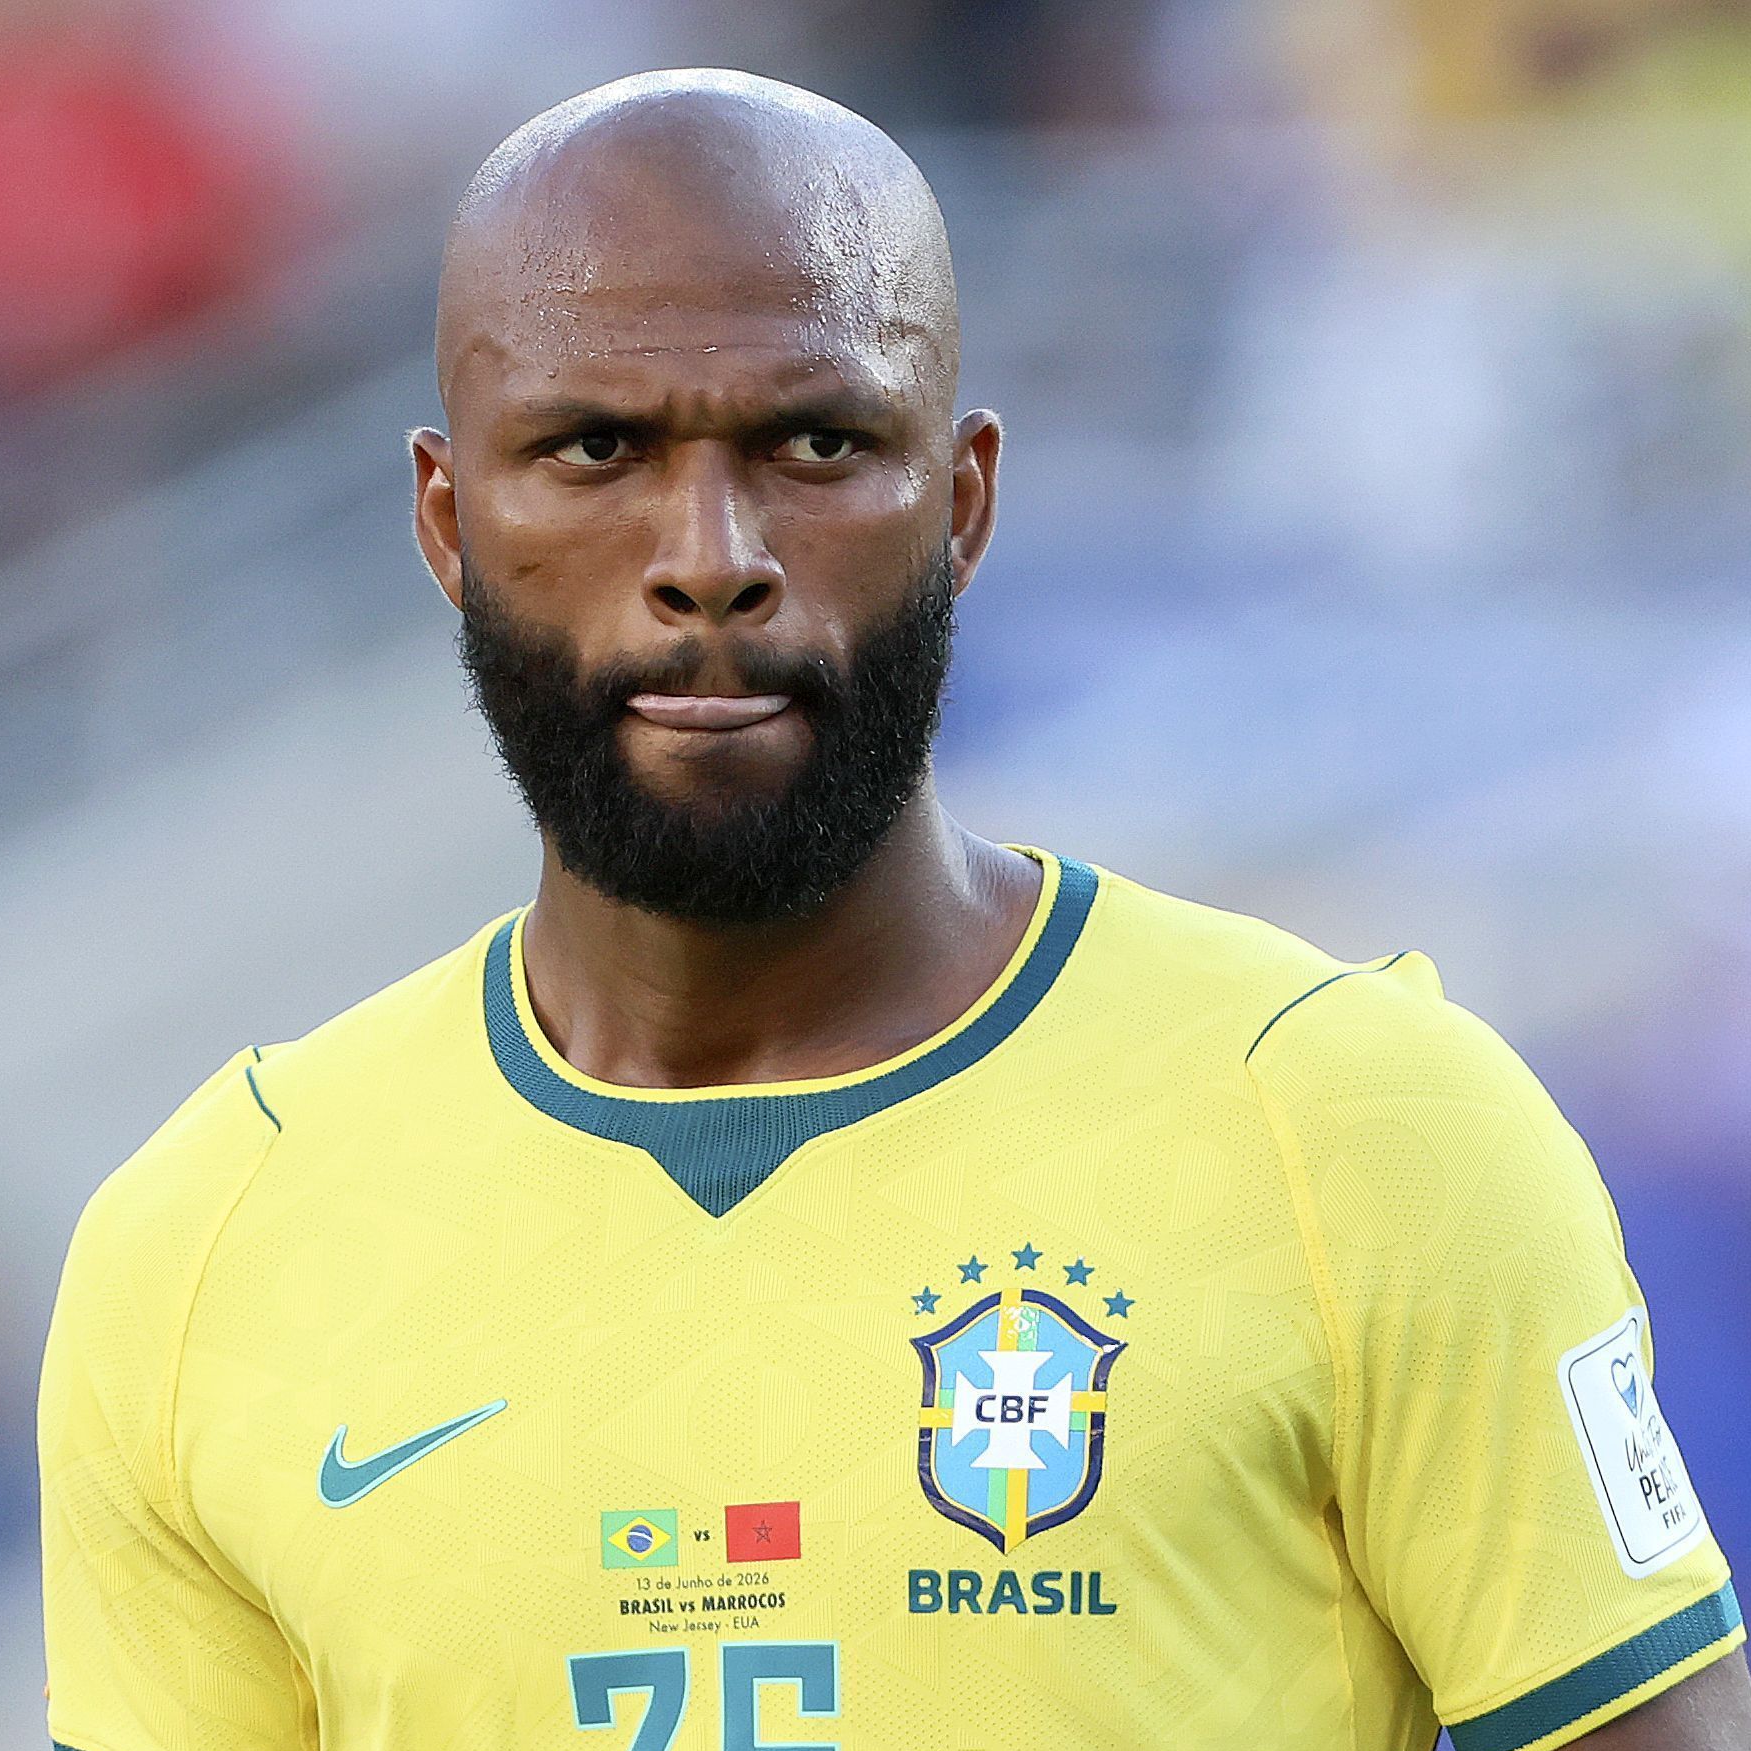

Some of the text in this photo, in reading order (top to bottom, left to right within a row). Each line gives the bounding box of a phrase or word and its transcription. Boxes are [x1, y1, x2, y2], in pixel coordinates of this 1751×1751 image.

[975, 1395, 1049, 1424] CBF
[1639, 1456, 1678, 1511] PEA
[693, 1529, 711, 1542] vs
[636, 1572, 770, 1591] 13 de Junho de 2026
[907, 1568, 1117, 1615] BRASIL
[619, 1592, 786, 1615] BRASIL vs MARROCOS
[649, 1620, 679, 1633] New
[682, 1619, 721, 1634] Jersey
[733, 1616, 760, 1629] EUA
